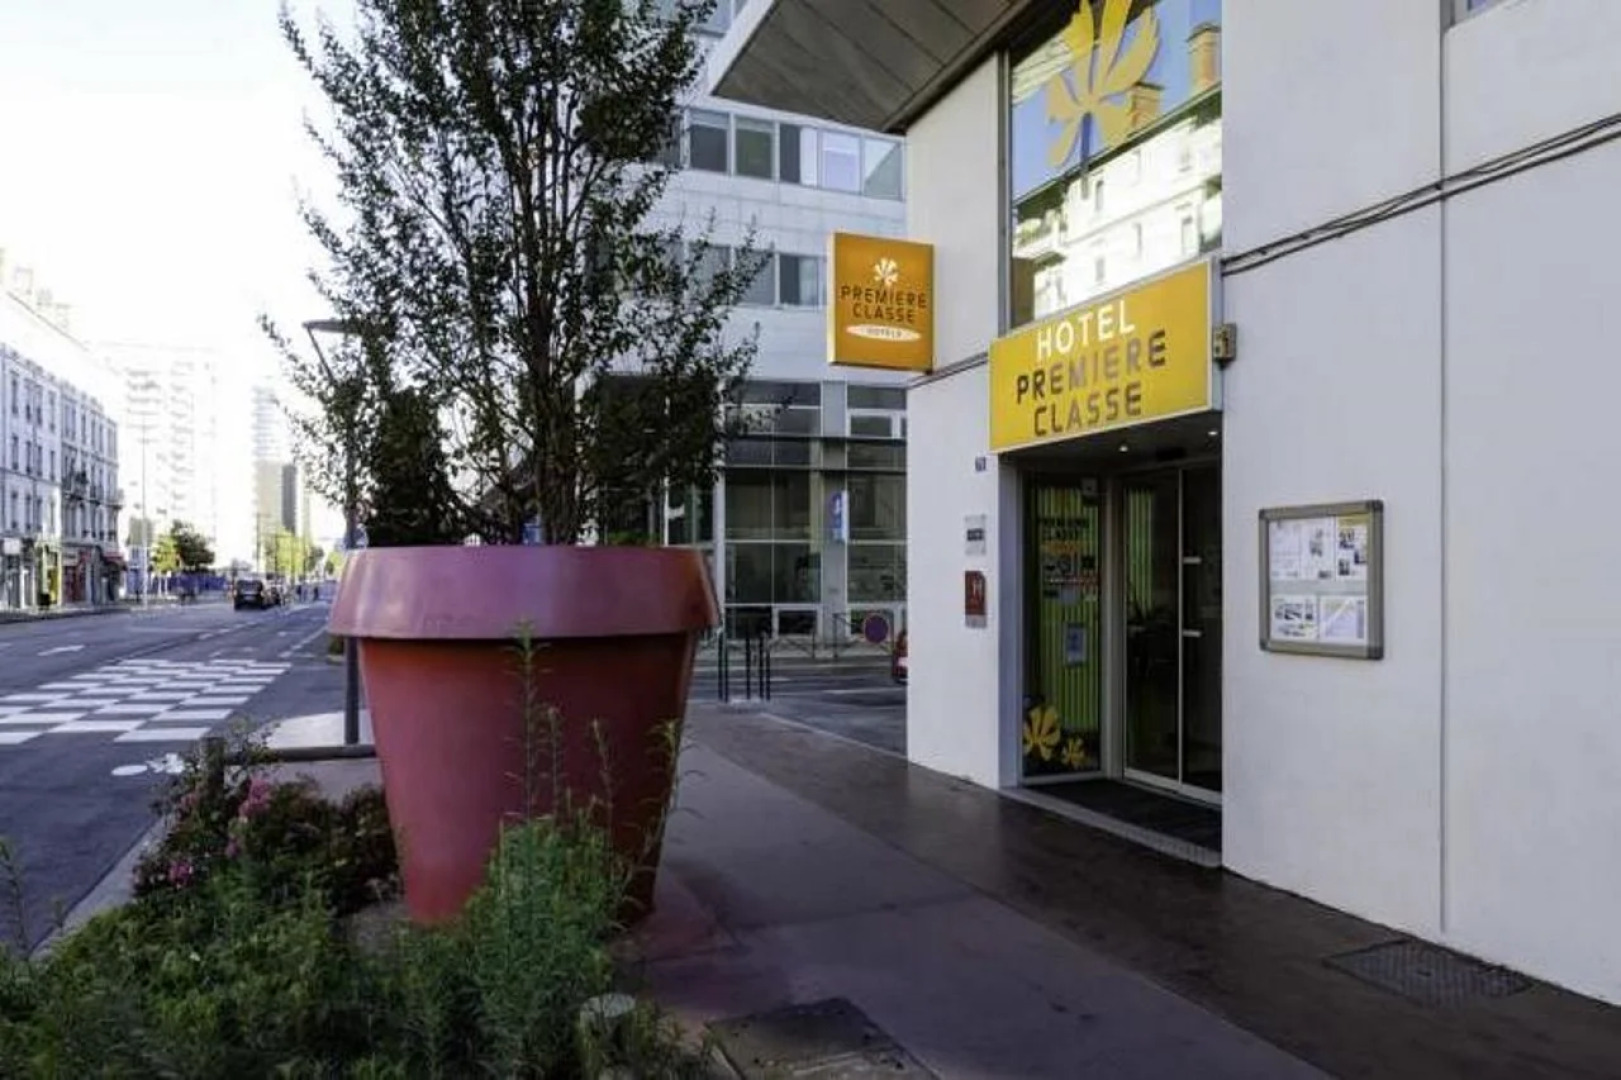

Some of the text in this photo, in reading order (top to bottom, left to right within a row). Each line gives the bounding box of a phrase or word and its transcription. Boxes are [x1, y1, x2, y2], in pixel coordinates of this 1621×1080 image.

[840, 284, 927, 310] PREMIERE
[852, 302, 915, 324] CLASSE
[1037, 299, 1136, 361] HOTEL
[1016, 328, 1166, 405] PREMIERE
[1034, 380, 1142, 436] CLASSE
